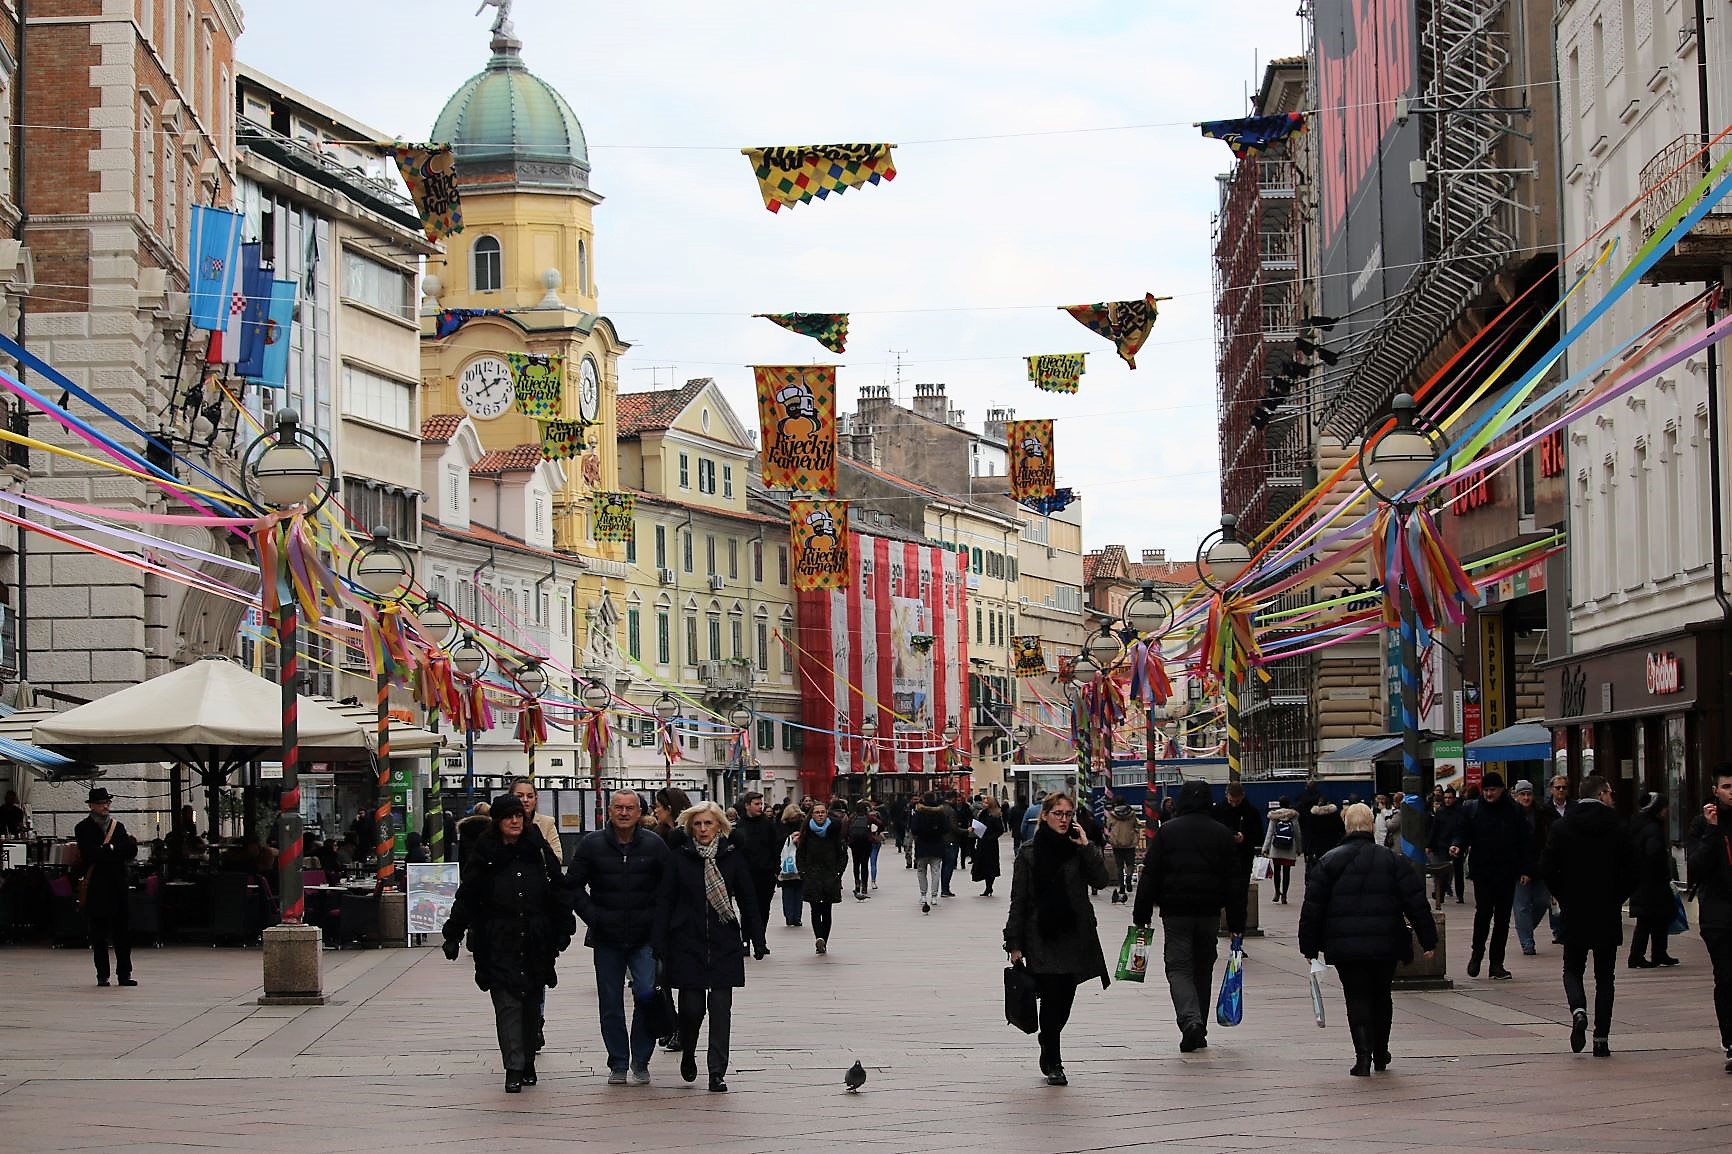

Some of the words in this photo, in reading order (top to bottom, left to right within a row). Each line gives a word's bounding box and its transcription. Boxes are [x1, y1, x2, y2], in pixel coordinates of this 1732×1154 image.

[484, 361, 493, 373] 12
[465, 370, 475, 382] 10
[461, 382, 469, 395] 9
[506, 381, 513, 393] 3
[465, 394, 474, 407] 8
[501, 393, 508, 404] 4
[483, 403, 491, 416] 6
[1488, 621, 1497, 690] HAPPY
